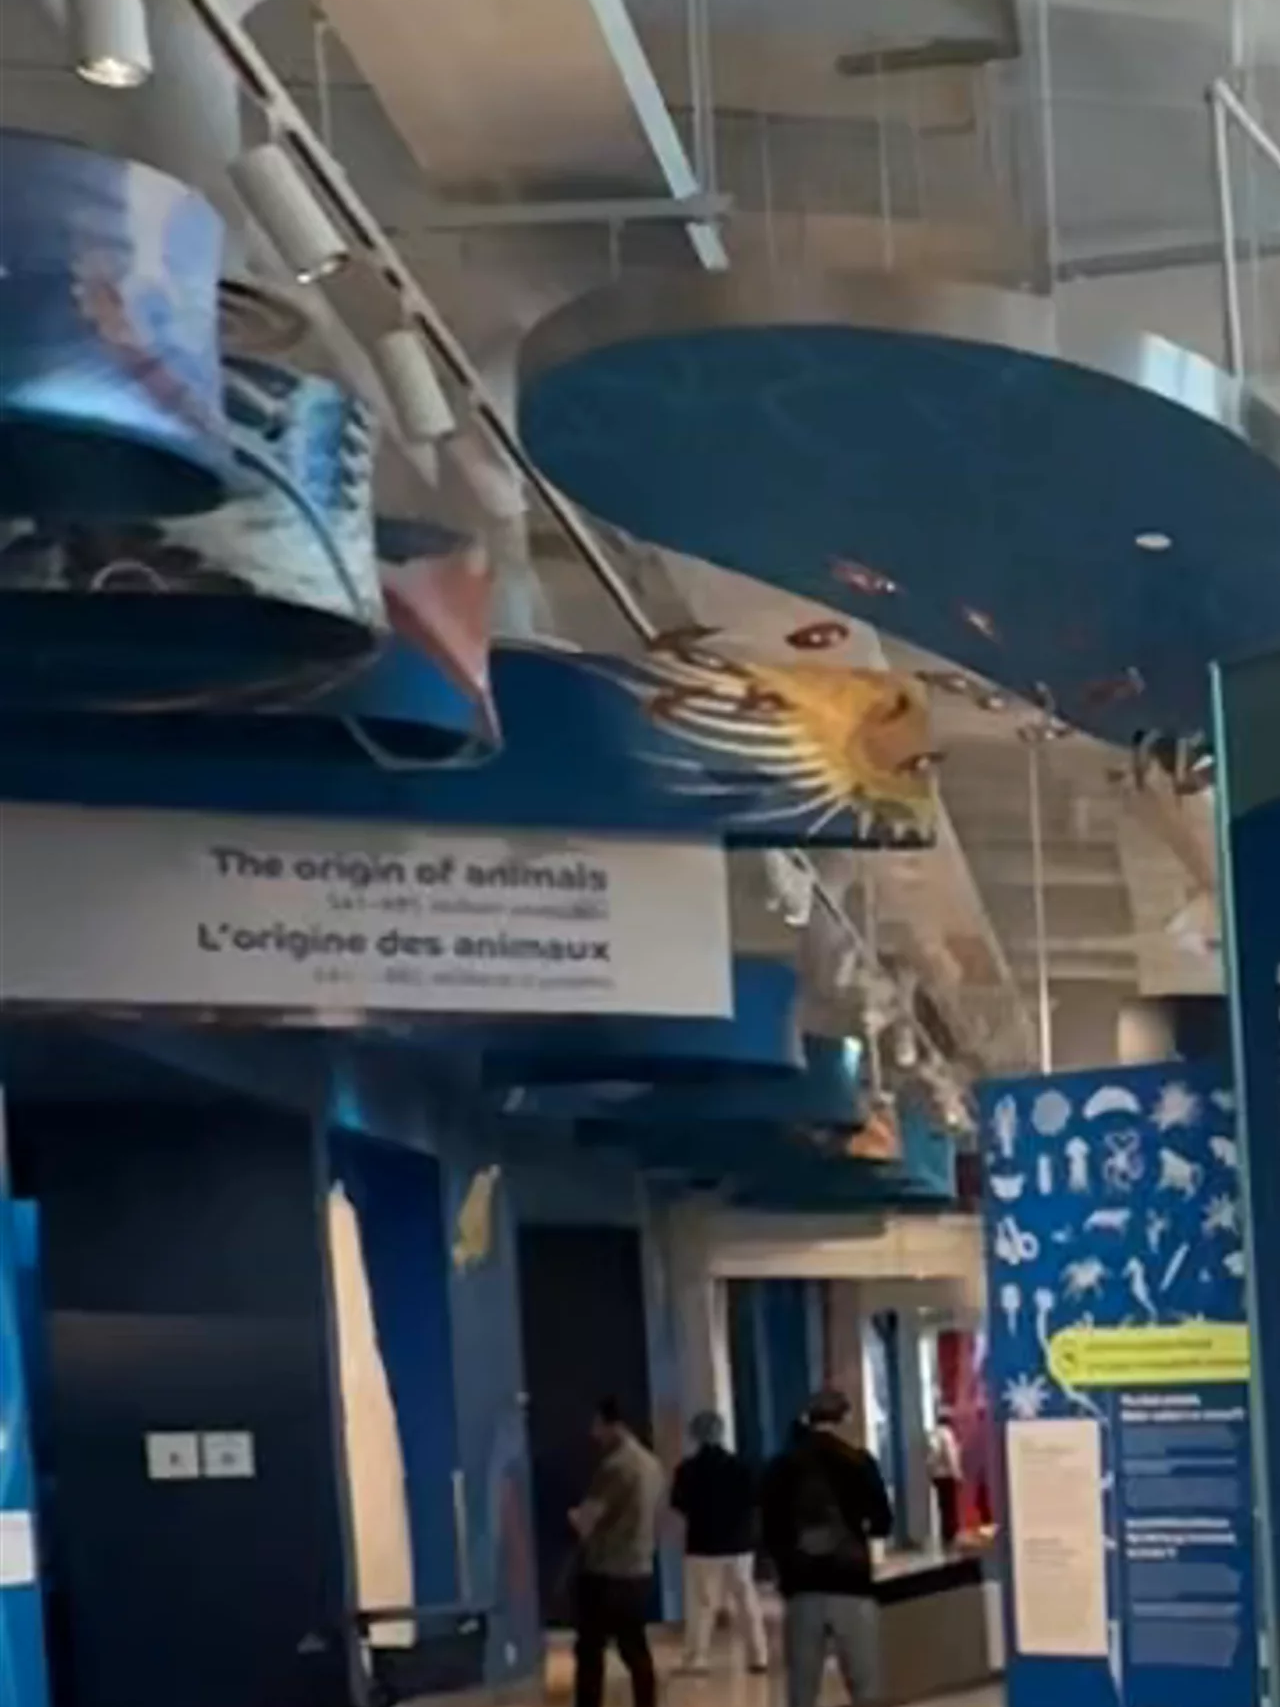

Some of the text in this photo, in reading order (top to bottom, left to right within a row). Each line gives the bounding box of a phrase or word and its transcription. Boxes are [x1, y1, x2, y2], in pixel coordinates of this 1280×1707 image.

[211, 846, 609, 892] The origin of animals
[376, 928, 441, 958] des
[454, 930, 612, 962] animaux
